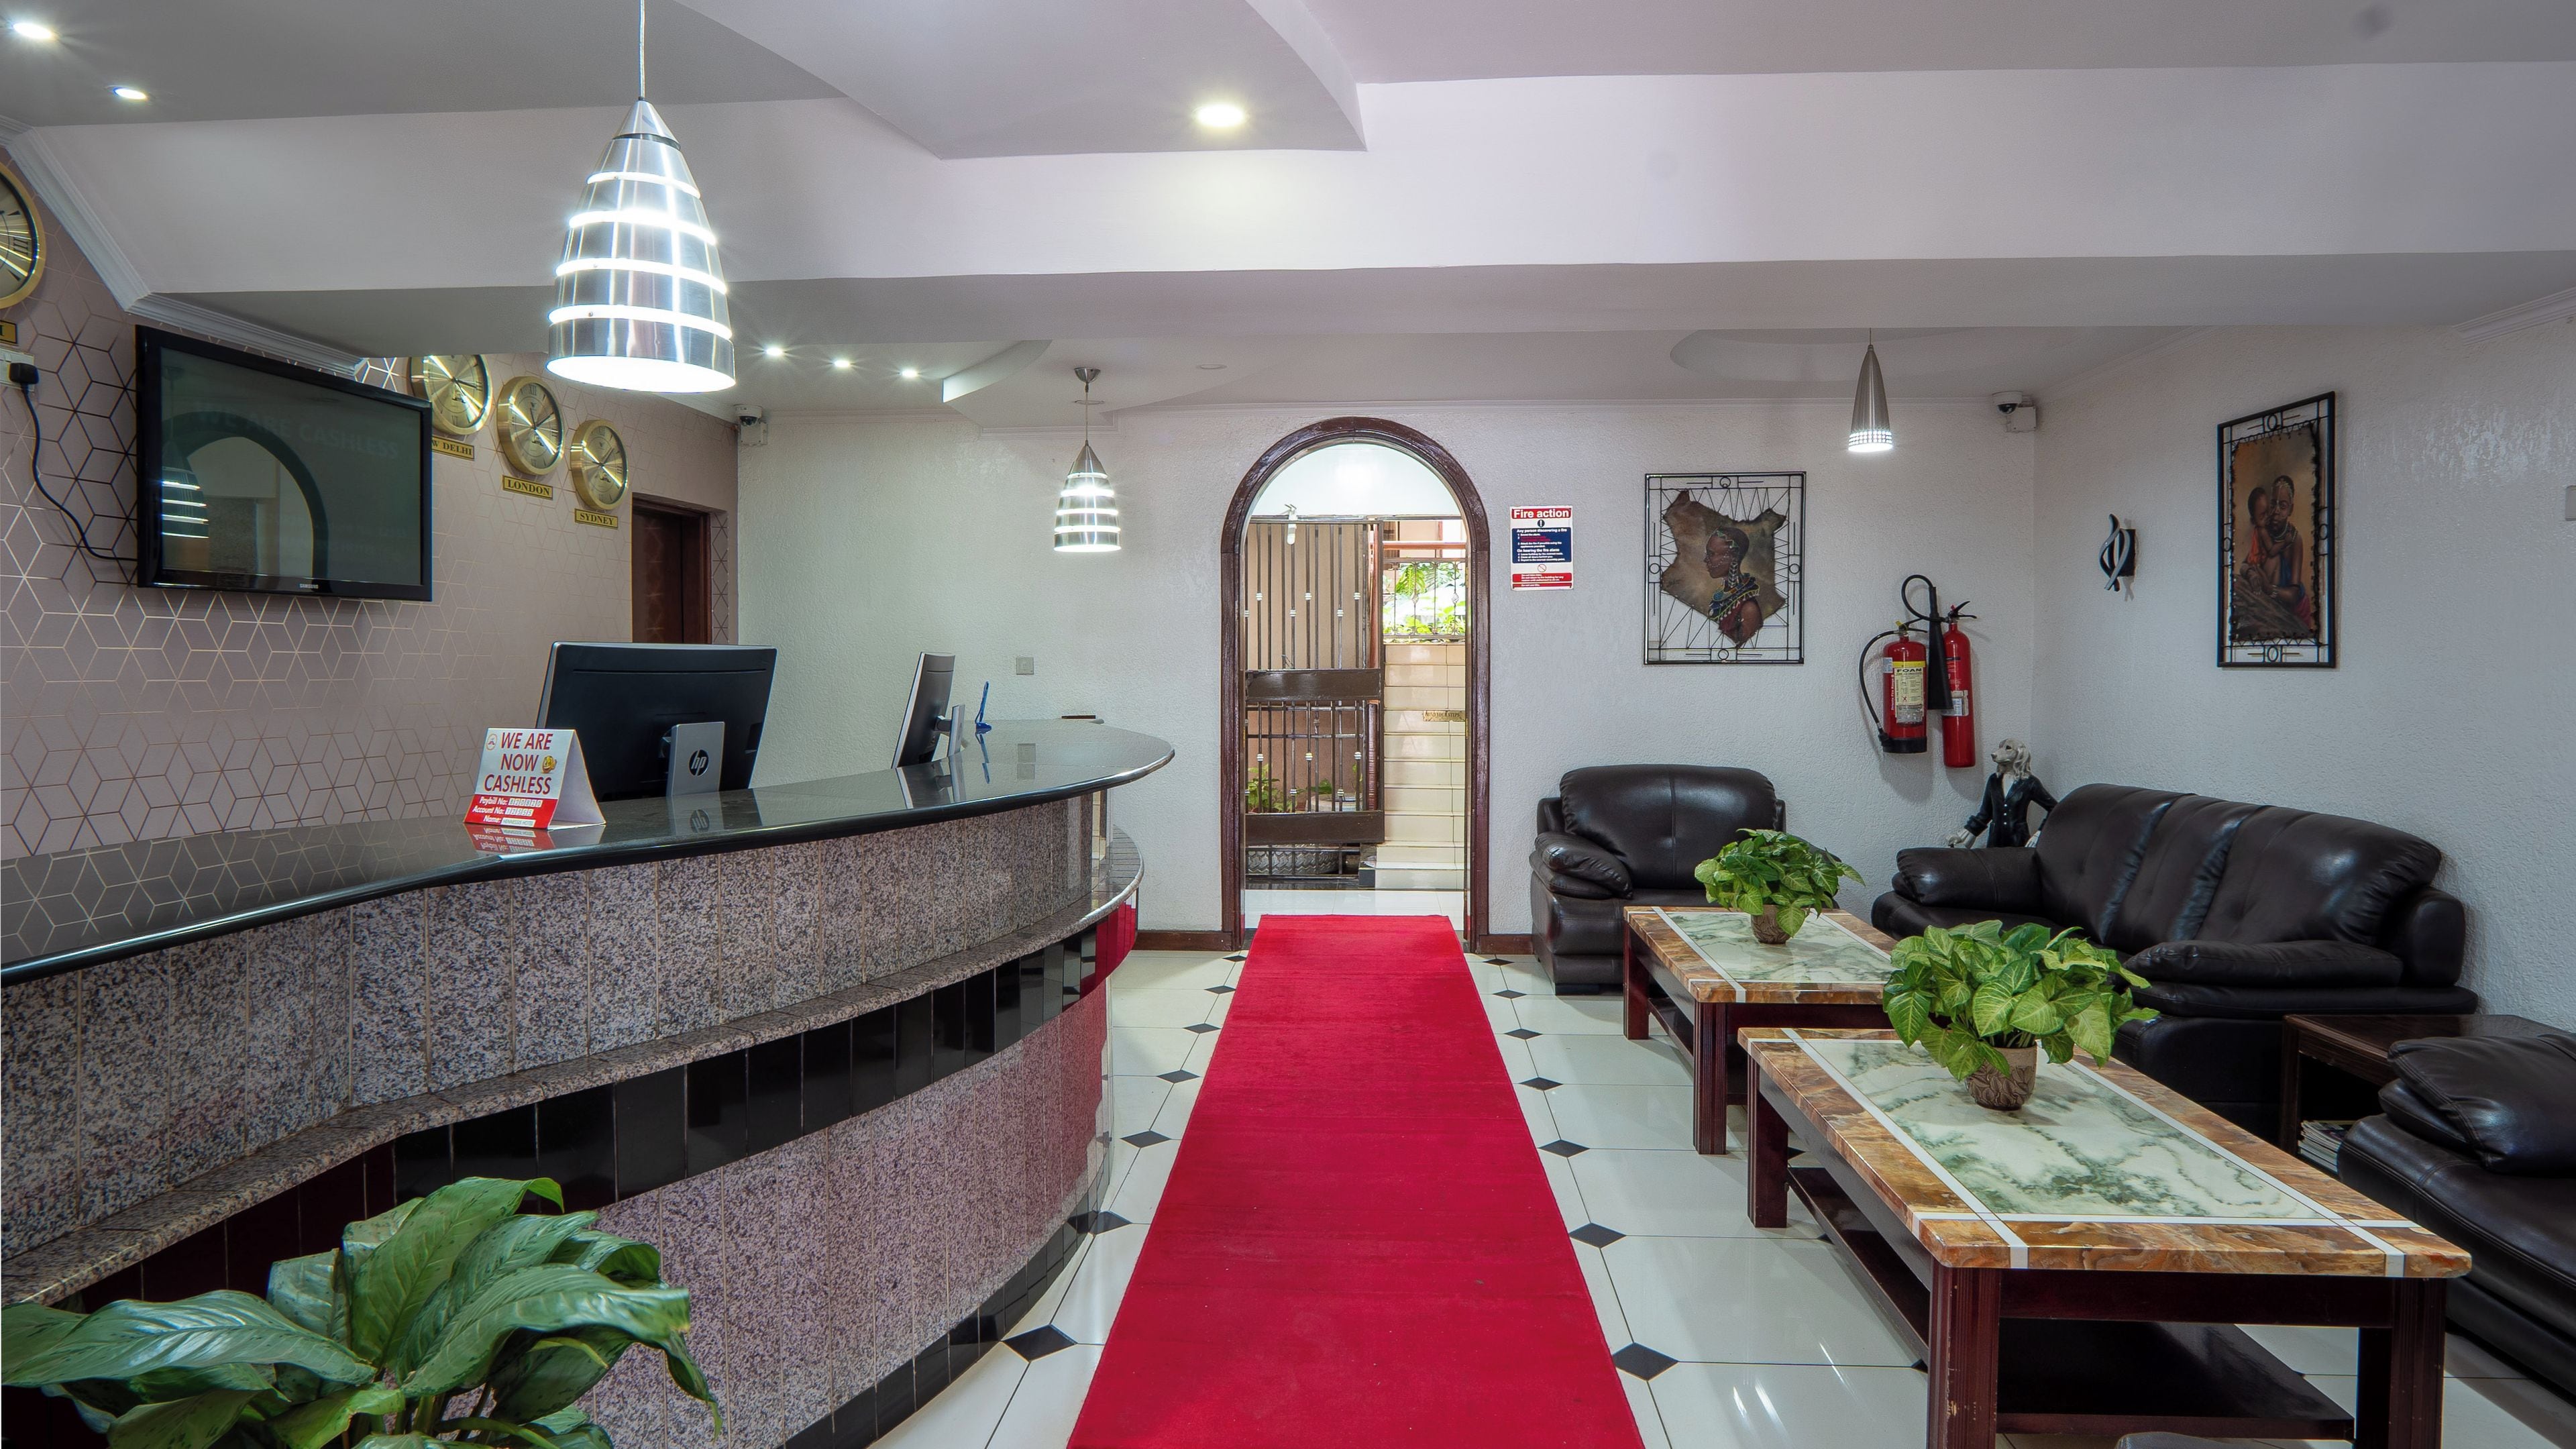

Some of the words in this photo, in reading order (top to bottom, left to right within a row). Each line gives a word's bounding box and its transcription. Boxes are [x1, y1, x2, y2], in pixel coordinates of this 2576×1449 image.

[299, 423, 400, 460] CASHLESS
[443, 442, 472, 455] DELHI
[507, 479, 551, 496] LONDON
[579, 512, 614, 526] SYDNEY
[1513, 510, 1534, 518] Fire
[1537, 508, 1569, 518] action
[500, 732, 523, 749] WE
[524, 733, 553, 750] ARE
[500, 753, 539, 771] NOW
[690, 749, 708, 776] hp
[484, 774, 552, 795] CASHLESS
[479, 796, 497, 806] Paybill
[497, 798, 508, 806] No:
[472, 805, 494, 814] Account
[483, 815, 502, 823] Name:
